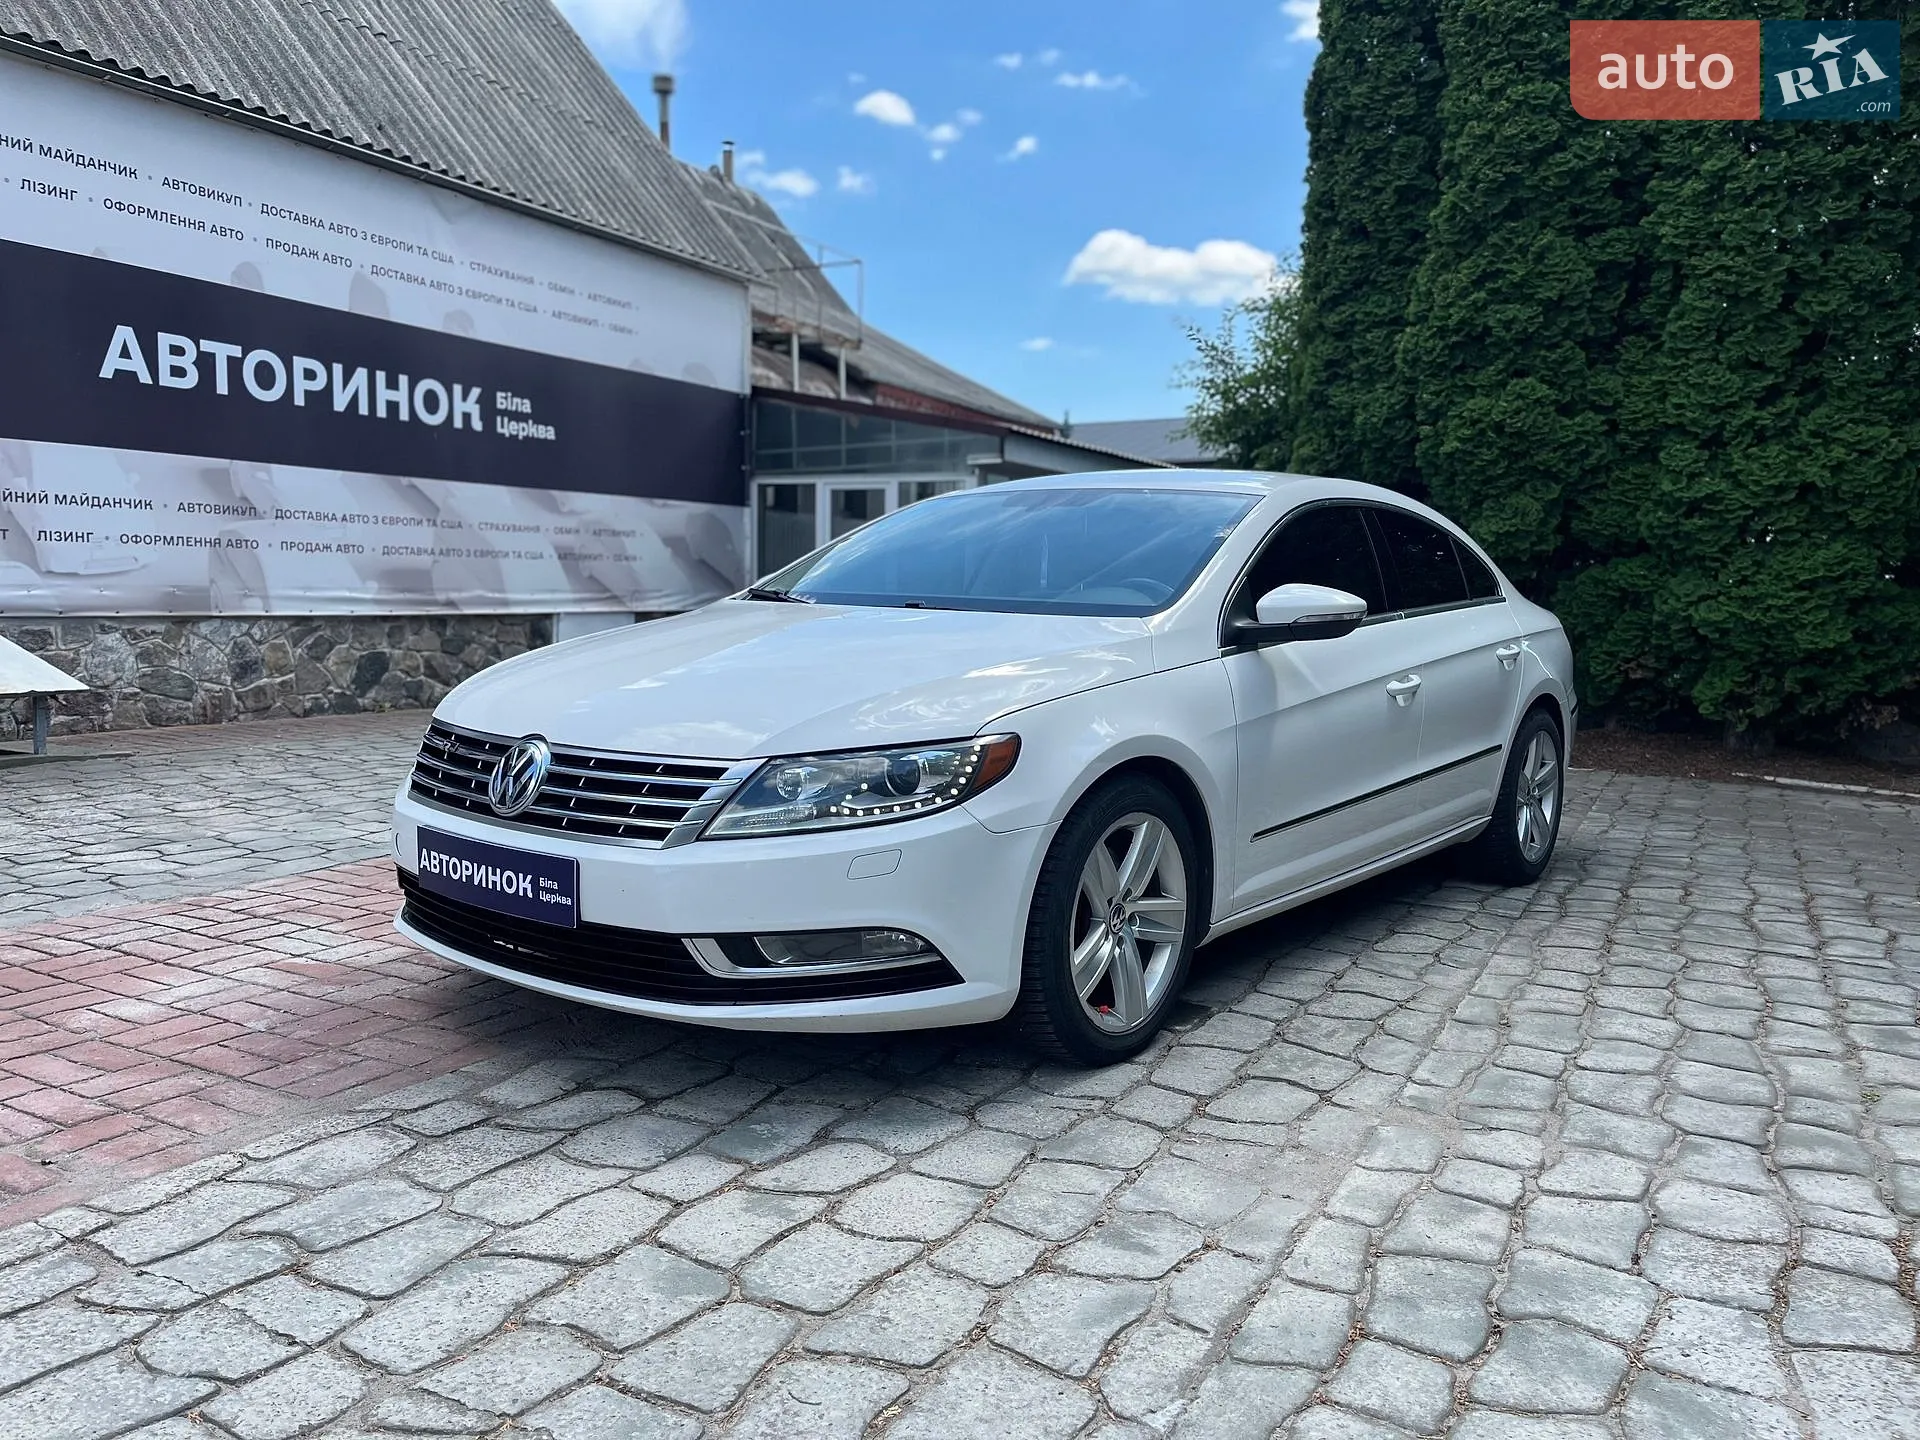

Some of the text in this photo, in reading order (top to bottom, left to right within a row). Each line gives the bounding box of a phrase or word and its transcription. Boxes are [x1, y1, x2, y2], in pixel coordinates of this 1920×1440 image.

[39, 144, 138, 179] МАЙДАНЧИК
[162, 176, 243, 207] АВТОВИКУП
[260, 203, 325, 230] ДОСТАВКА
[328, 222, 358, 238] АВТО
[370, 233, 414, 253] ЄВРОПИ
[416, 246, 429, 257] ТА
[431, 250, 454, 264] США
[469, 261, 535, 285] СТРАХУВАННЯ
[20, 178, 78, 200] ЛІЗИНГ
[103, 197, 206, 232] ОФОРМЛЕННЯ
[210, 224, 244, 241] АВТО
[266, 238, 320, 261] ПРОДАЖ
[322, 252, 353, 269] АВТО
[371, 264, 427, 287] ДОСТАВКА
[429, 279, 454, 294] АВТО
[465, 288, 503, 305] ЄВРОПИ
[505, 298, 516, 309] ТА
[518, 301, 538, 313] США
[98, 325, 483, 432] АВТОРИНОК
[495, 391, 532, 414] Біла
[495, 416, 556, 441] Церква
[54, 492, 153, 510] МАЙДАНЧИК
[177, 501, 257, 518] АВТОВИКУП
[275, 508, 338, 522] ДОСТАВКА
[341, 513, 370, 524] АВТО
[381, 516, 424, 527] ЄВРОПИ
[426, 519, 438, 528] ТА
[441, 520, 464, 529] США
[478, 521, 541, 533] СТРАХУВАННЯ
[37, 530, 94, 543] ЛІЗИНГ
[120, 533, 222, 549] ОФОРМЛЕННЯ
[225, 538, 260, 551] АВТО
[280, 541, 333, 553] ПРОДАЖ
[335, 544, 365, 554] АВТО
[382, 546, 435, 557] ДОСТАВКА
[438, 547, 464, 558] АВТО
[473, 549, 510, 559] ЄВРОПИ
[512, 550, 523, 560] ТА
[525, 551, 545, 560] США
[419, 848, 533, 899] АВТОРИНОК
[539, 877, 559, 890] Біла
[539, 890, 572, 906] Церква
